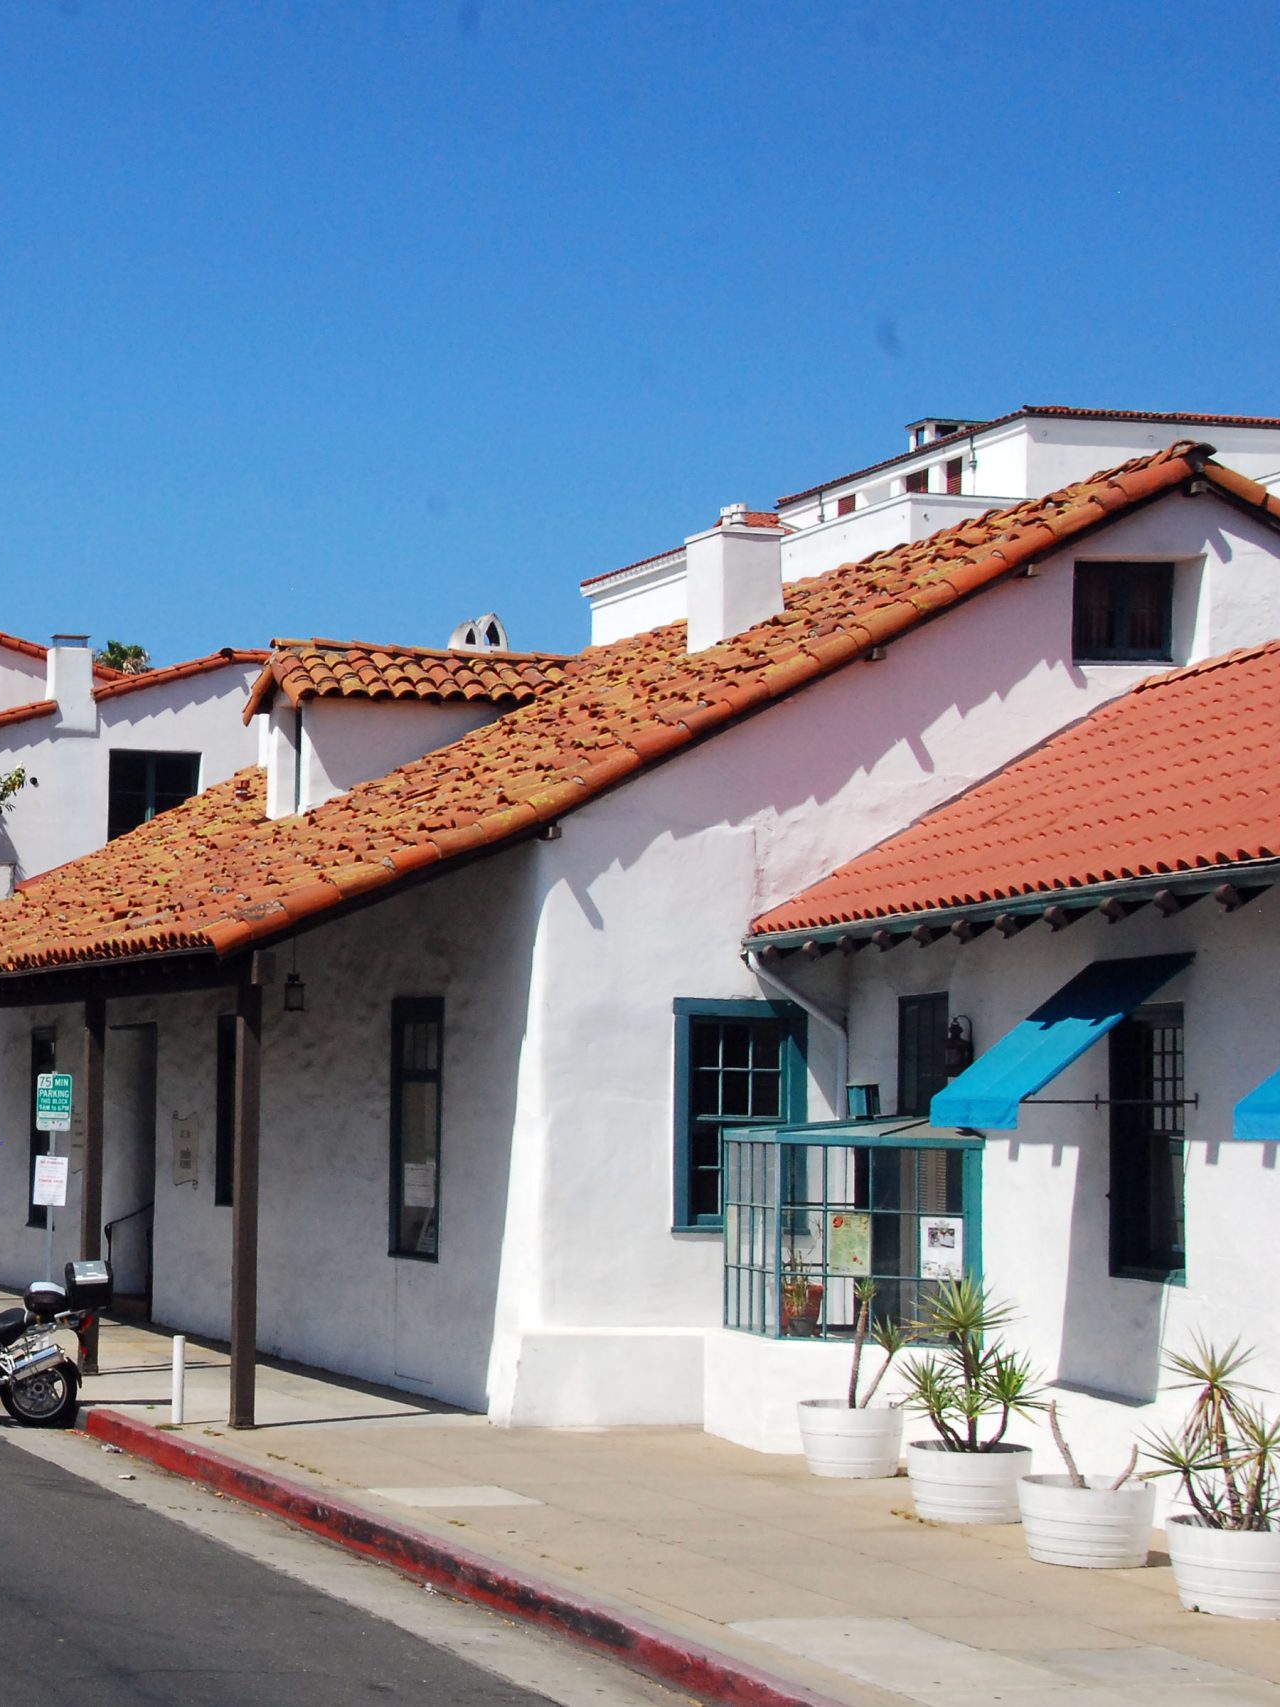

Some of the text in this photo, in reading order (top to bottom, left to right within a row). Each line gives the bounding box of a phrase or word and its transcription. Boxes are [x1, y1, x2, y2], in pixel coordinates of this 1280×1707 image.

[39, 1076, 69, 1088] 75 MIN
[39, 1089, 70, 1098] PARKING
